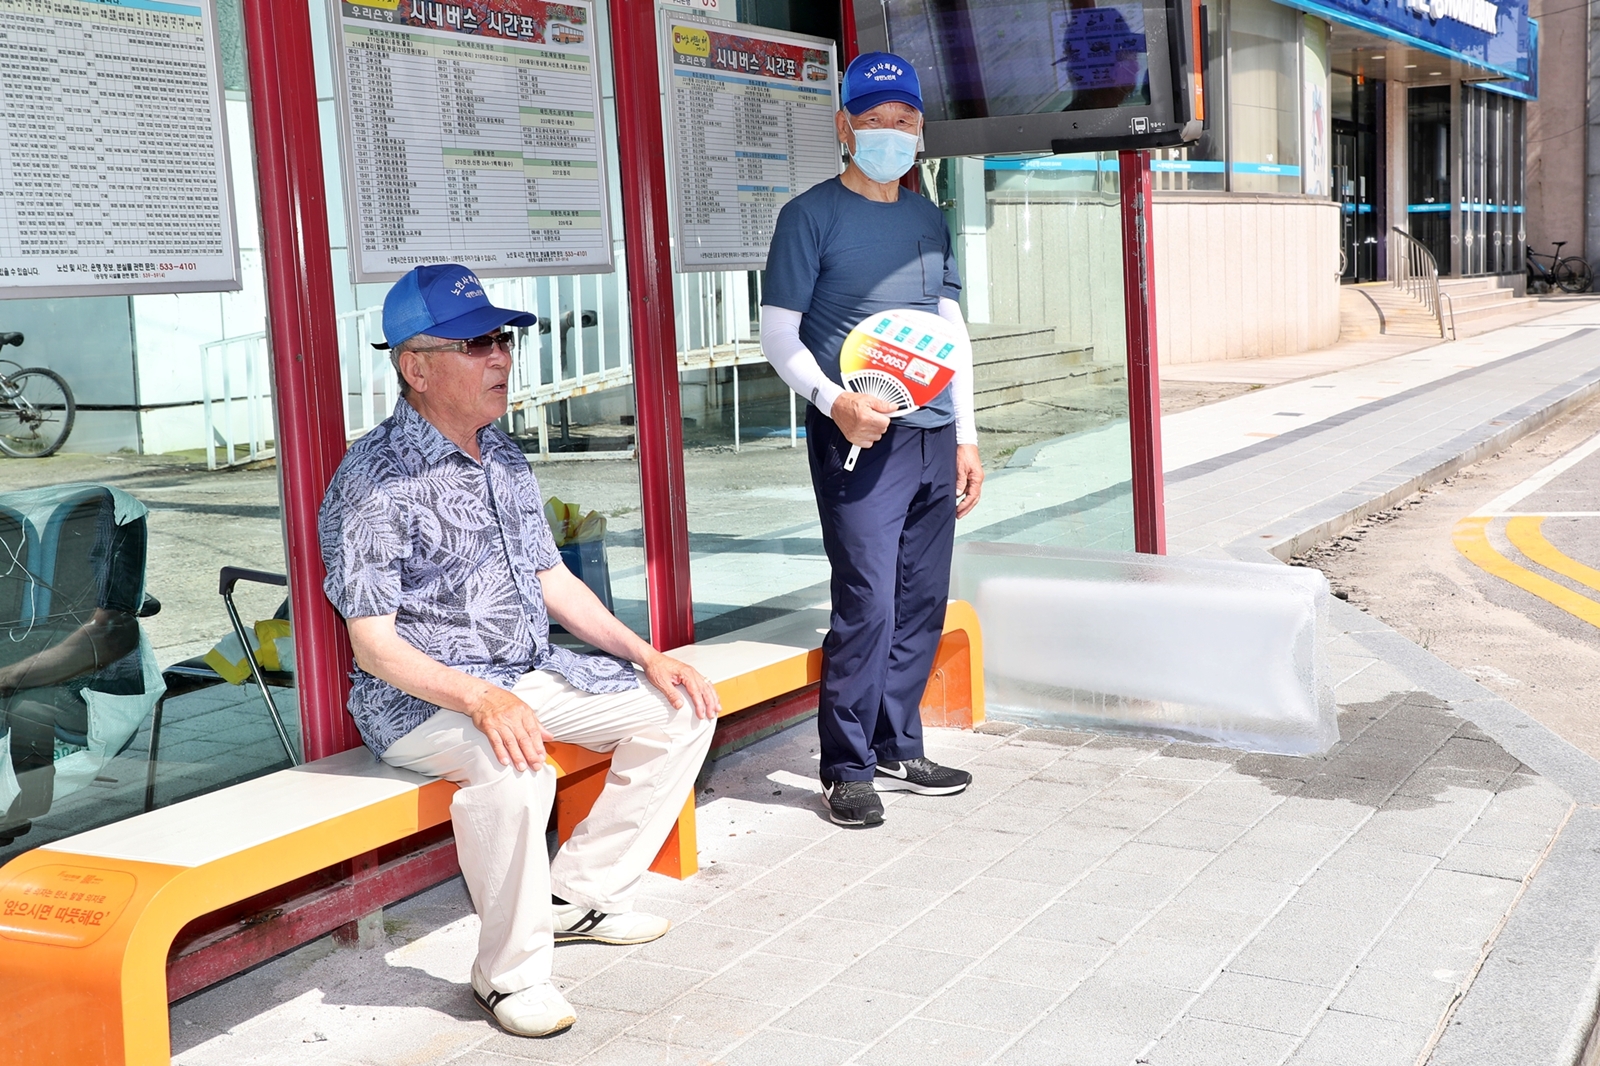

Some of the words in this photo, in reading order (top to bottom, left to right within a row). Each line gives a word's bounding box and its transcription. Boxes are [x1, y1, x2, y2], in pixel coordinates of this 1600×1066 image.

[352, 6, 393, 22] 우리은행
[410, 0, 478, 29] 시내버스
[488, 10, 534, 37] 시간표
[680, 55, 706, 67] 우리은행
[716, 48, 760, 71] 시내버스
[765, 54, 796, 76] 시간표
[17, 267, 40, 276] 있습니다.
[57, 264, 68, 272] 노선
[91, 264, 101, 272] 운행
[866, 347, 907, 371] 533-0053
[33, 888, 53, 897] 의자는
[69, 892, 84, 901] 발열
[85, 894, 106, 904] 의자로
